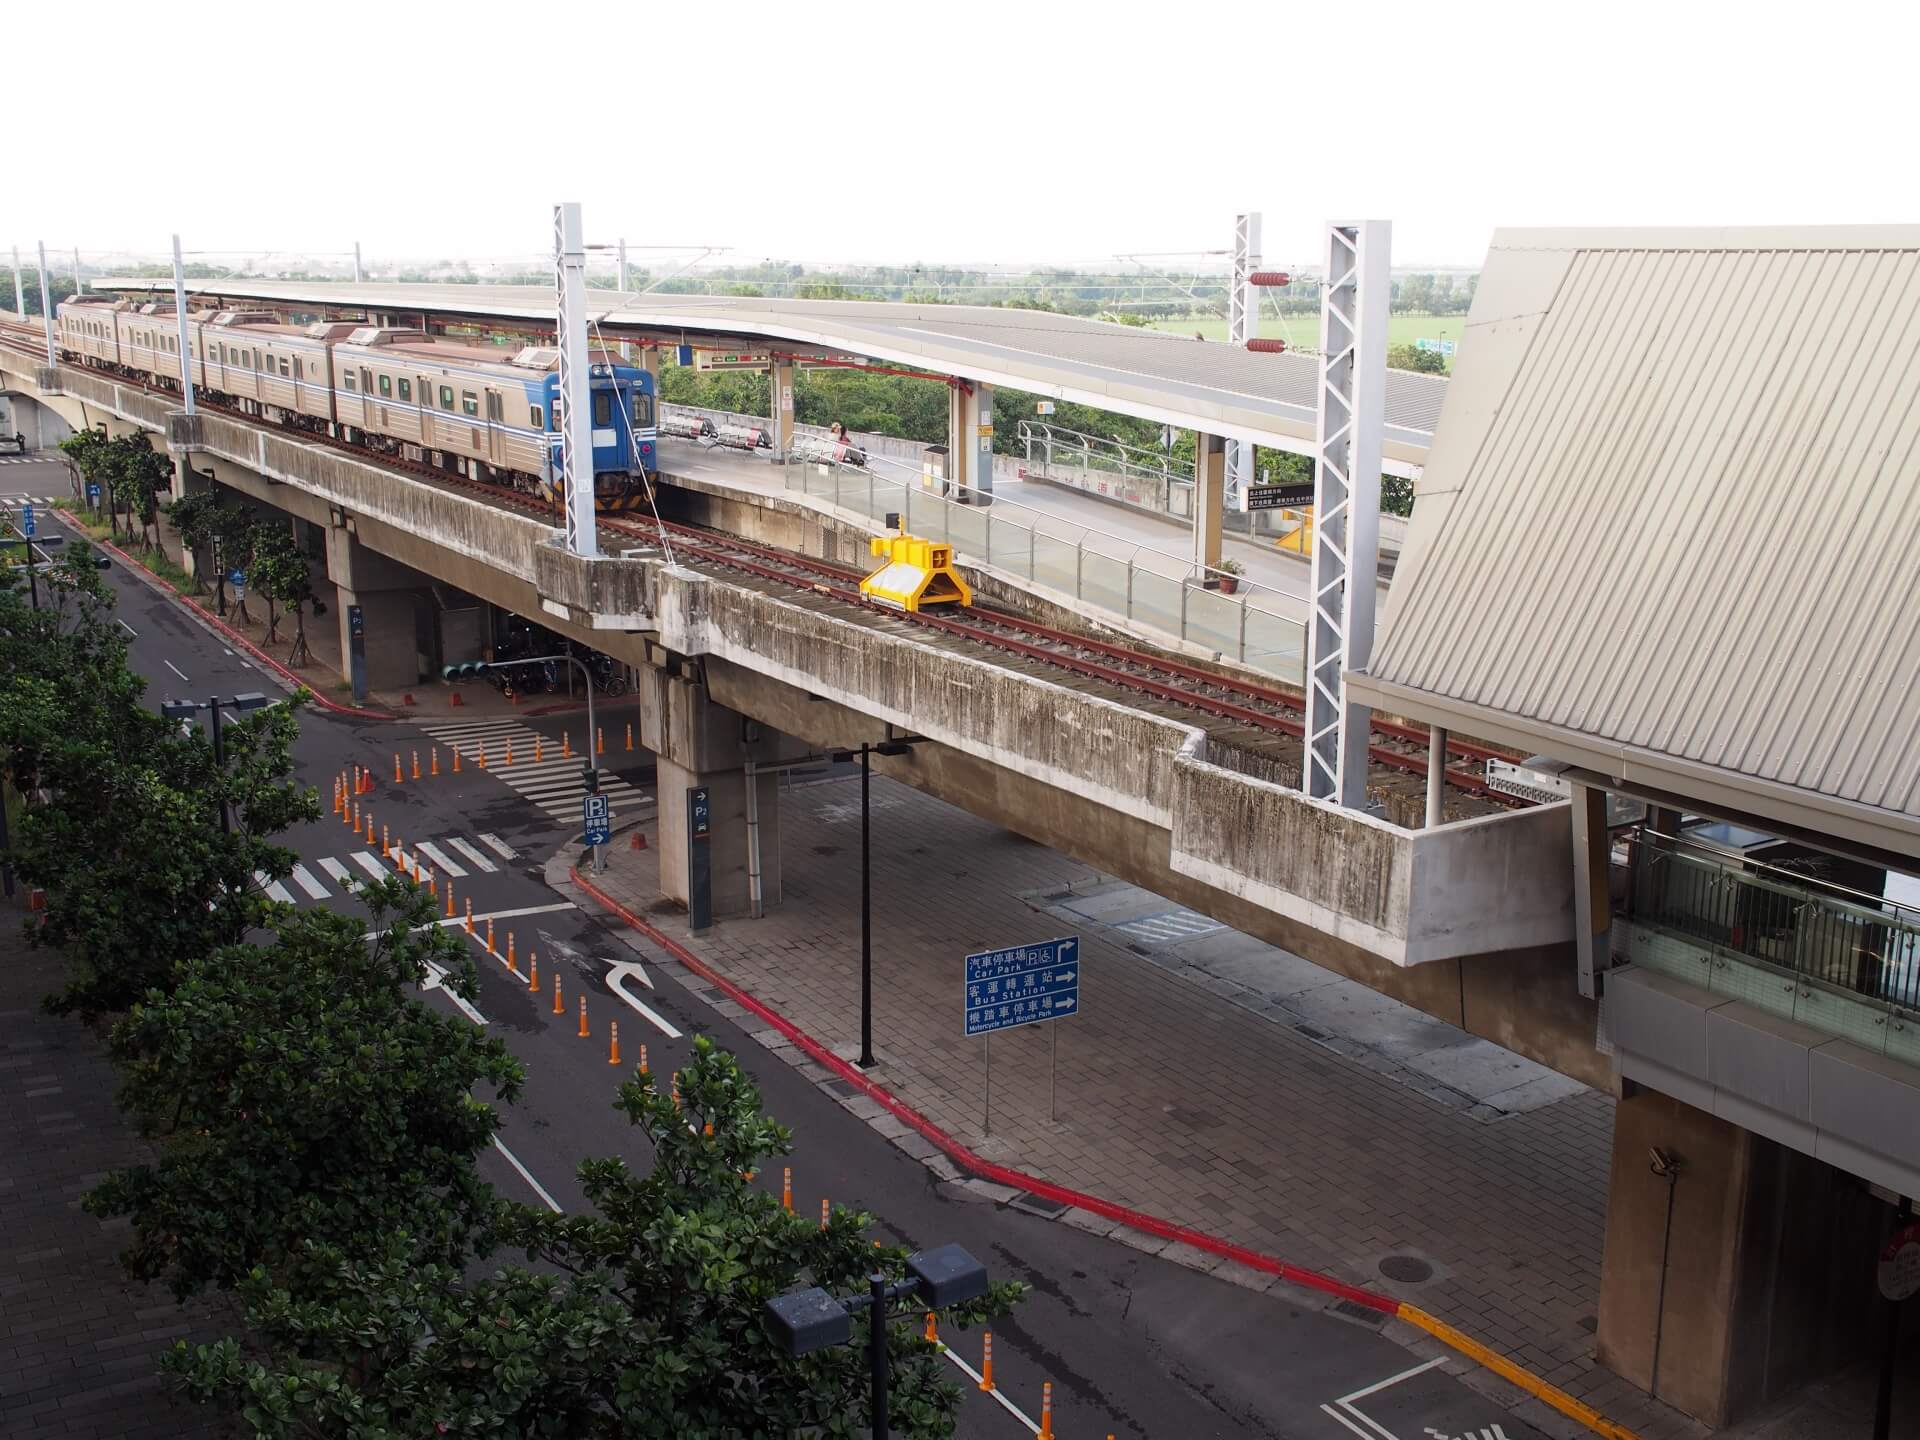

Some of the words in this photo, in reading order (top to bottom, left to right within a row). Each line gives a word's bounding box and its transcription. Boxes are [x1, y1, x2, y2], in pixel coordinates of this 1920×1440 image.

[589, 798, 604, 817] P2
[969, 948, 1026, 971] 汽車停車場
[974, 969, 993, 979] Car
[997, 965, 1021, 974] Park
[969, 970, 1053, 998] 客運轉運站
[975, 995, 996, 1006] Bus
[1002, 985, 1046, 1001] Station
[969, 1020, 1000, 1032] Motorcycle
[1002, 1017, 1014, 1026] and
[1016, 1013, 1037, 1024] Bicycle
[1038, 1010, 1052, 1019] Park
